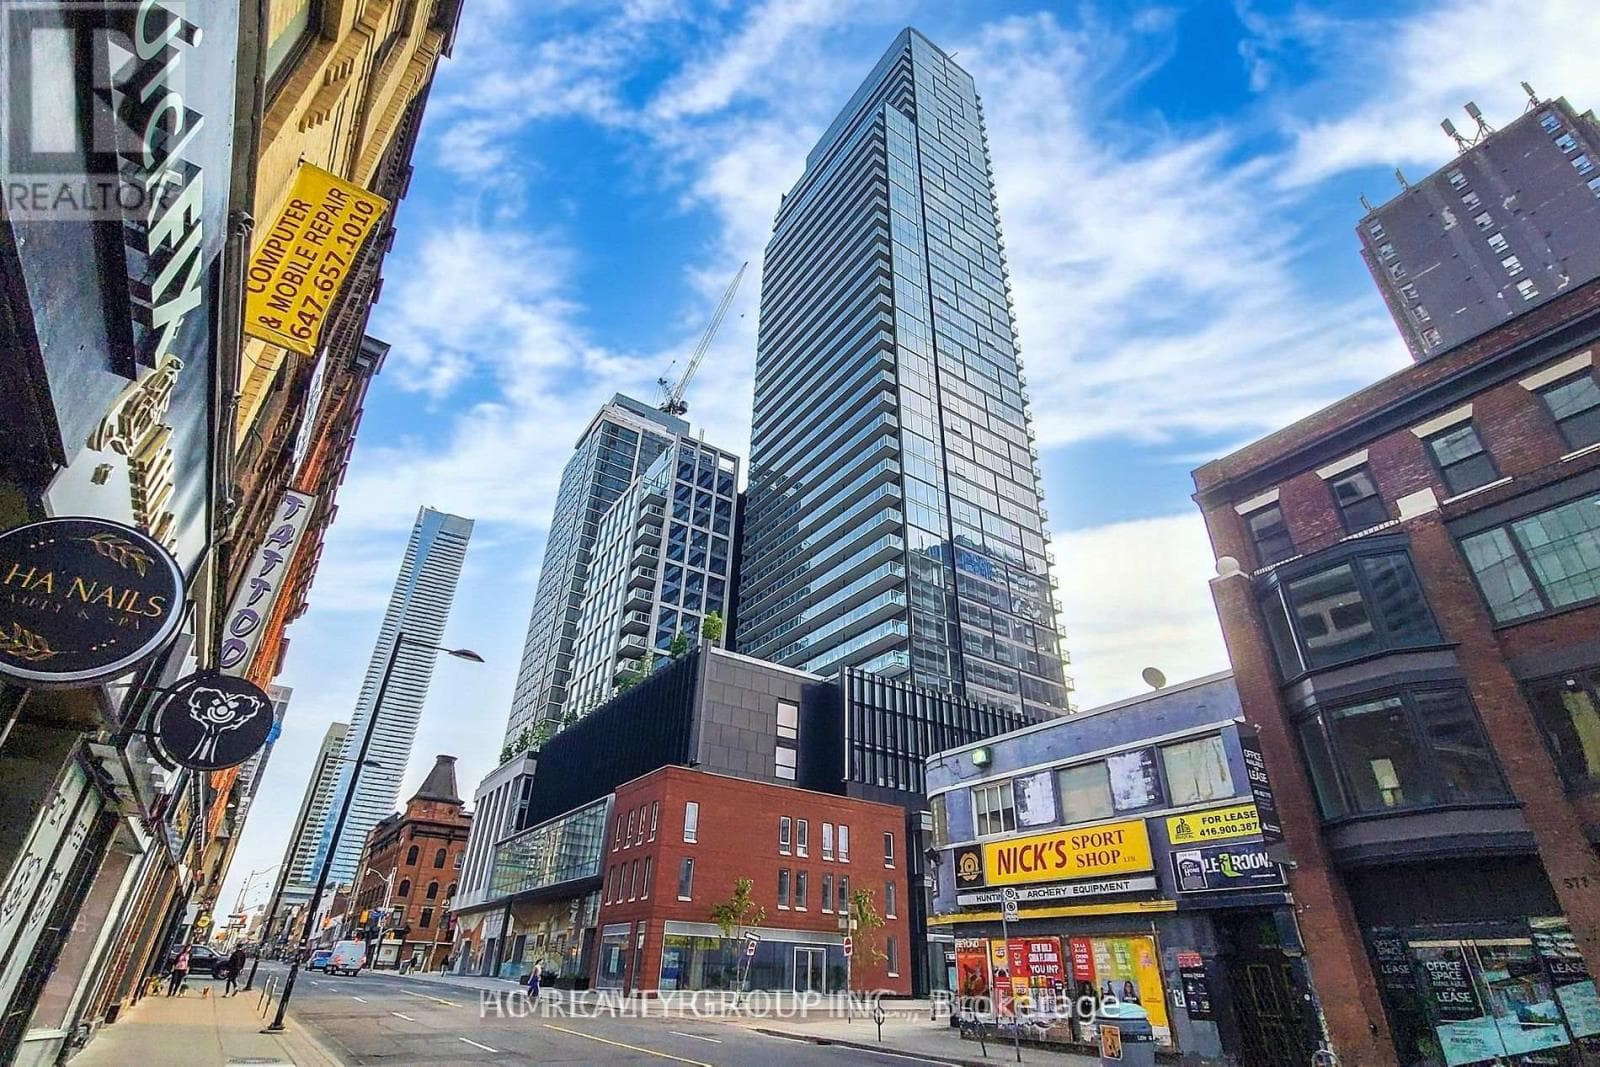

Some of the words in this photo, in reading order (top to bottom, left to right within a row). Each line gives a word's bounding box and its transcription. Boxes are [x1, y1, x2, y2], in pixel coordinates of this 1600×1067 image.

[304, 188, 350, 246] REPAIR
[248, 199, 313, 293] COMPUTER
[290, 200, 375, 341] 647.657.1010
[266, 246, 318, 313] MOBILE
[258, 315, 282, 329] &
[220, 494, 306, 669] TATTOO
[66, 577, 166, 617] NAILS
[1201, 815, 1221, 825] FOR
[1224, 810, 1257, 822] LEASE
[997, 839, 1068, 875] NICK'S
[1072, 829, 1125, 850] SPORT
[1076, 850, 1121, 868] SHOP
[1027, 888, 1067, 898] ARCHERY
[1073, 881, 1130, 894] EQUIPMENT
[1030, 965, 1047, 974] YOU
[1426, 961, 1462, 971] OFFICE
[1551, 962, 1586, 974] LEASE
[1431, 971, 1464, 981] SPACE
[1436, 992, 1473, 1003] LEASE
